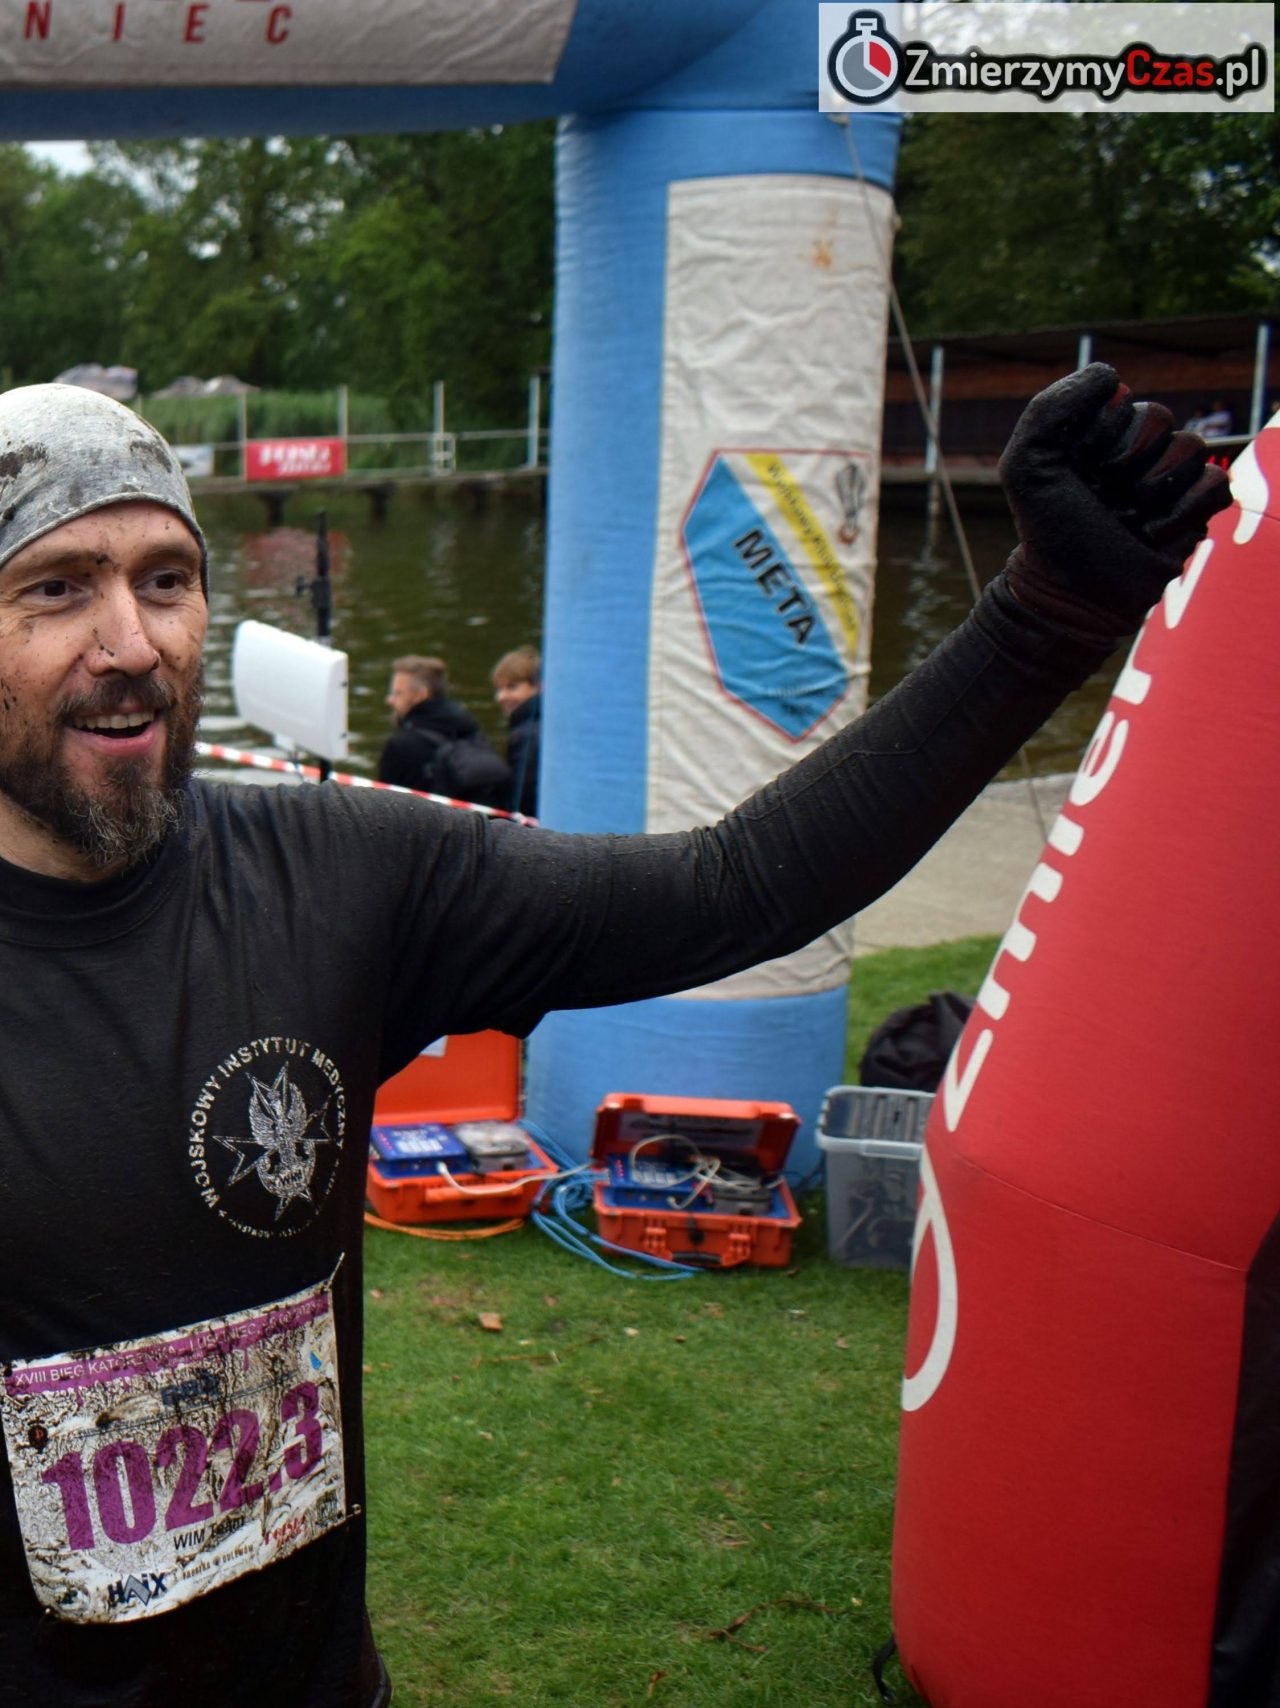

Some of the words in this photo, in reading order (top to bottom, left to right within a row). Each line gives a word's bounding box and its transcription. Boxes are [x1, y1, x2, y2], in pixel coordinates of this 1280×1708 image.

[734, 528, 816, 646] META
[188, 1075, 222, 1208] WOJSKOWY
[217, 1036, 311, 1078] INSTYTUT
[311, 1048, 346, 1150] MEDYCZNY
[15, 1371, 47, 1387] XVIII
[50, 1364, 85, 1382] BIEG
[41, 1381, 323, 1551] 10223
[173, 1528, 205, 1550] WIM
